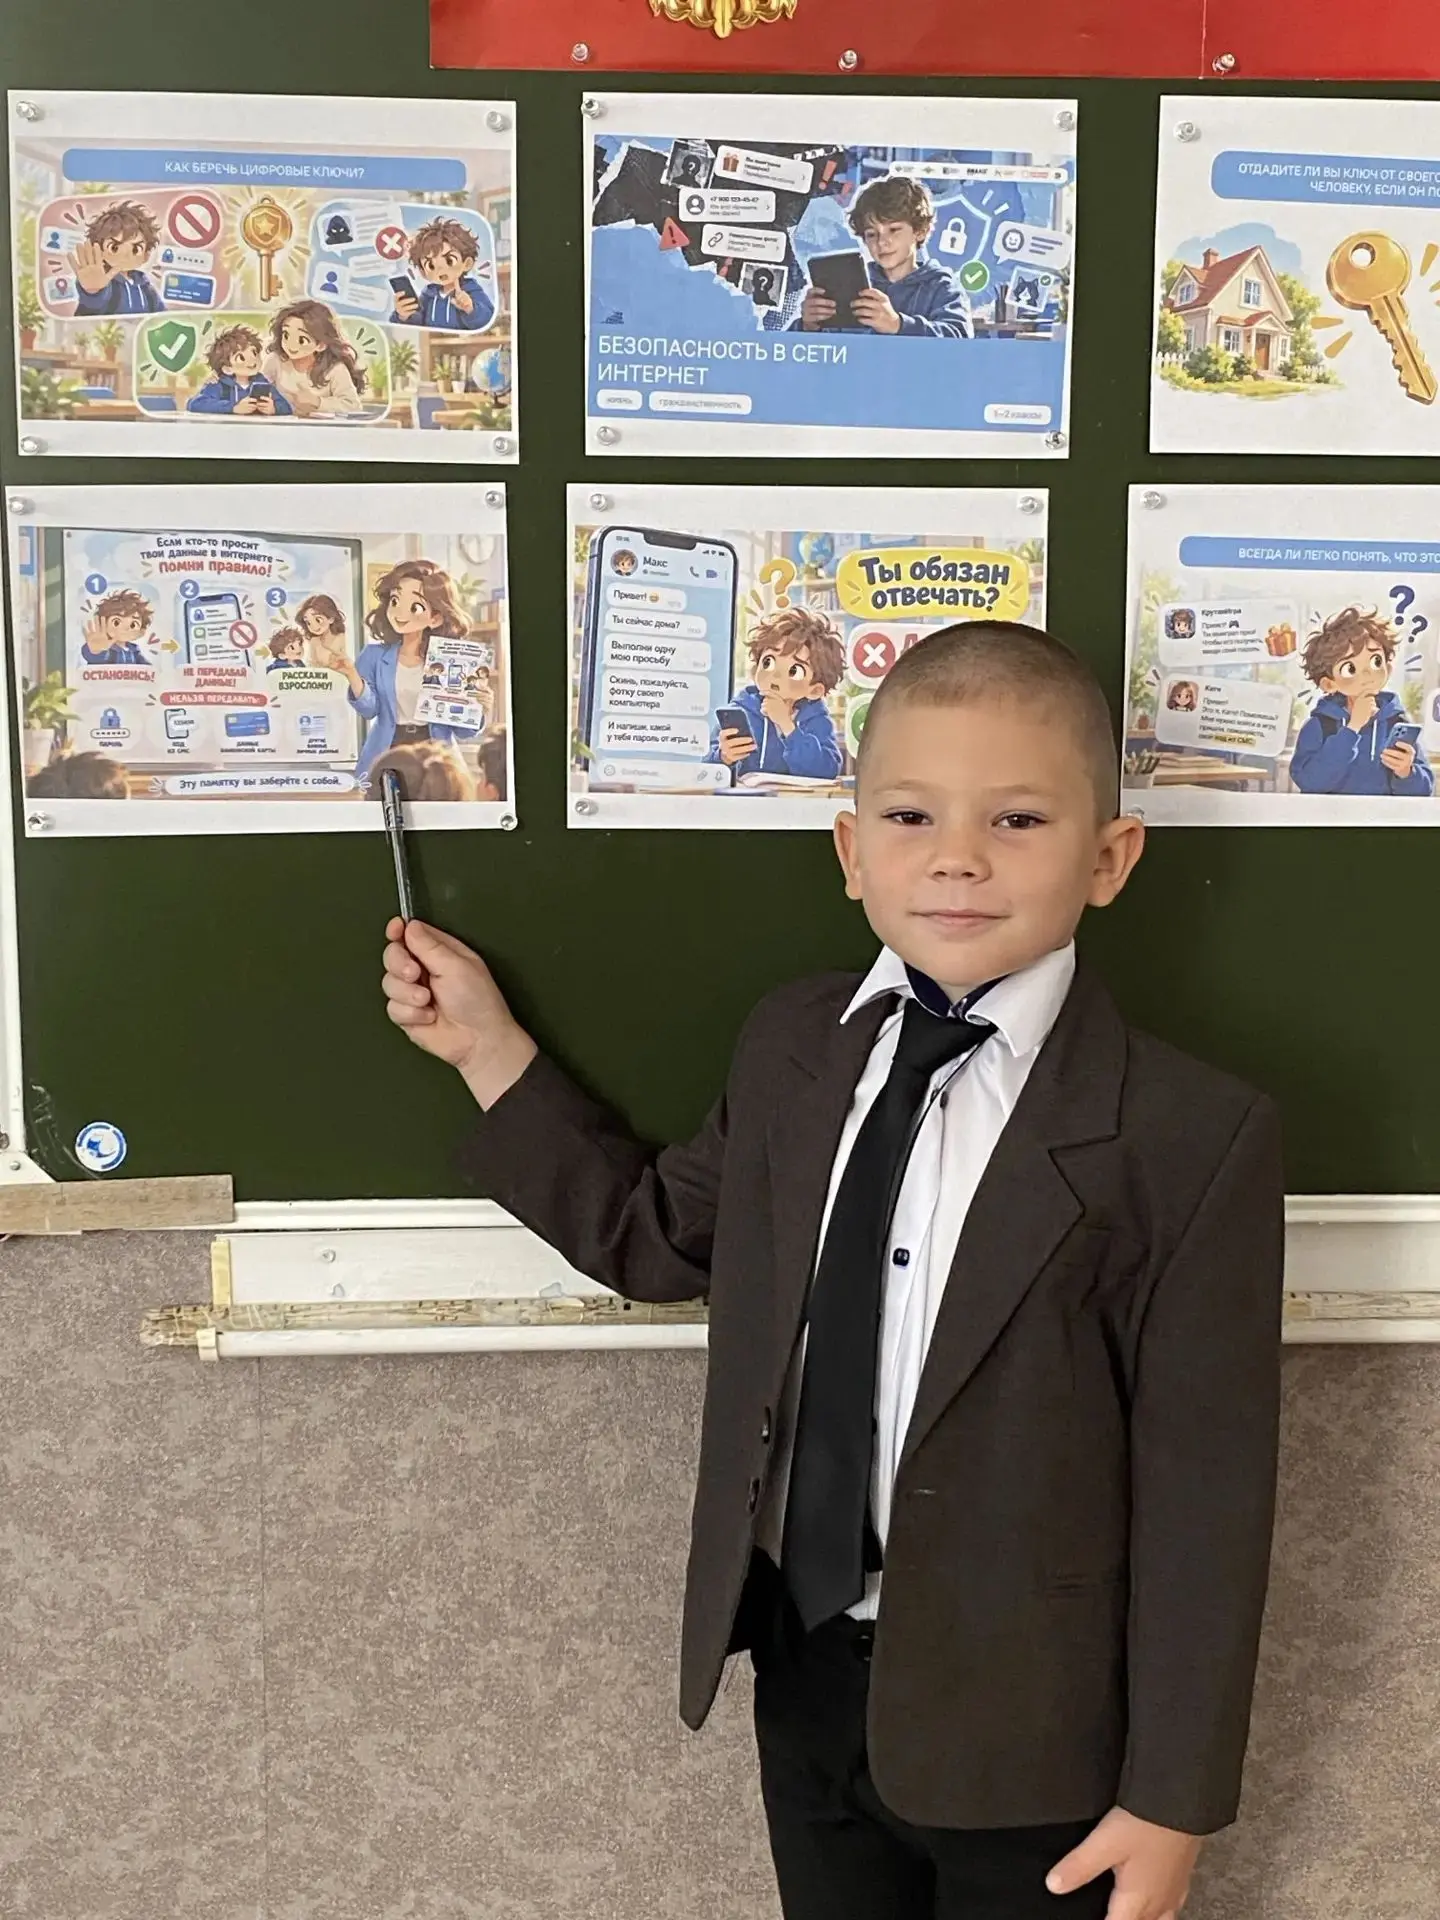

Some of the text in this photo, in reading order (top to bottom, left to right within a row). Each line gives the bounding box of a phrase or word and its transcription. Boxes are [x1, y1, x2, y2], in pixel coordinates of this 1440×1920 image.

[164, 161, 365, 179] КАК БЕРЕЧЬ ЦИФРОВЫЕ КЛЮЧИ?
[1238, 162, 1301, 177] ОТДАДИТЕ
[1303, 165, 1320, 177] ЛИ
[1323, 166, 1341, 178] ВЫ
[1343, 167, 1378, 180] КЛЮЧ
[1380, 168, 1396, 180] ОТ
[1310, 180, 1372, 196] ЧЕЛОВЕКУ,
[1374, 183, 1406, 196] ЕСЛИ
[1408, 184, 1425, 197] ОН
[598, 335, 848, 364] БЕЗОПАСНОСТЬ В СЕТИ
[597, 363, 709, 386] ИНТЕРНЕТ
[156, 537, 260, 550] Если кто-то просит
[140, 551, 165, 560] твои
[168, 549, 208, 559] данные
[210, 549, 217, 557] в
[220, 550, 273, 563] интернете
[642, 556, 668, 568] Макс
[1238, 547, 1282, 560] ВСЕГДА
[1284, 548, 1301, 560] ЛИ
[1303, 549, 1340, 561] ЛЕГКО
[1342, 550, 1392, 564] ПОНЯТЬ,
[1395, 551, 1417, 563] ЧТО
[208, 560, 273, 577] правило!
[858, 555, 1010, 586] Ты обязан
[91, 578, 100, 591] 1
[184, 583, 194, 596] 2
[760, 558, 795, 608] ?
[271, 590, 281, 604] 3
[613, 589, 647, 601] Привет!
[871, 586, 1000, 612] отвечать?
[1389, 585, 1415, 626] ?
[612, 615, 624, 624] Ты
[625, 616, 653, 627] сейчас
[654, 620, 680, 630] дома?
[1408, 614, 1429, 643] ?
[611, 641, 676, 656] Выполни одну
[610, 653, 671, 665] мою просьбу
[82, 670, 156, 683] ОСТАНОВИСЬ!
[183, 667, 247, 677] НЕ ПЕРЕДАВАЙ
[282, 671, 328, 680] РАССКАЖИ
[195, 678, 237, 688] ДАННЫЕ!
[278, 681, 333, 691] ВЗРОСЛОМУ!
[609, 675, 690, 690] Скинь, пожалуйста,
[169, 694, 205, 703] НЕЛЬЗЯ
[609, 688, 664, 698] фотку своего
[608, 699, 661, 709] компьютера
[608, 721, 615, 730] И
[650, 722, 671, 731] какой
[606, 735, 611, 743] у
[613, 733, 631, 741] тебя
[633, 734, 660, 742] пароль
[670, 735, 689, 744] игры
[179, 776, 342, 790] Эту памятку вы заберёте с собой.
